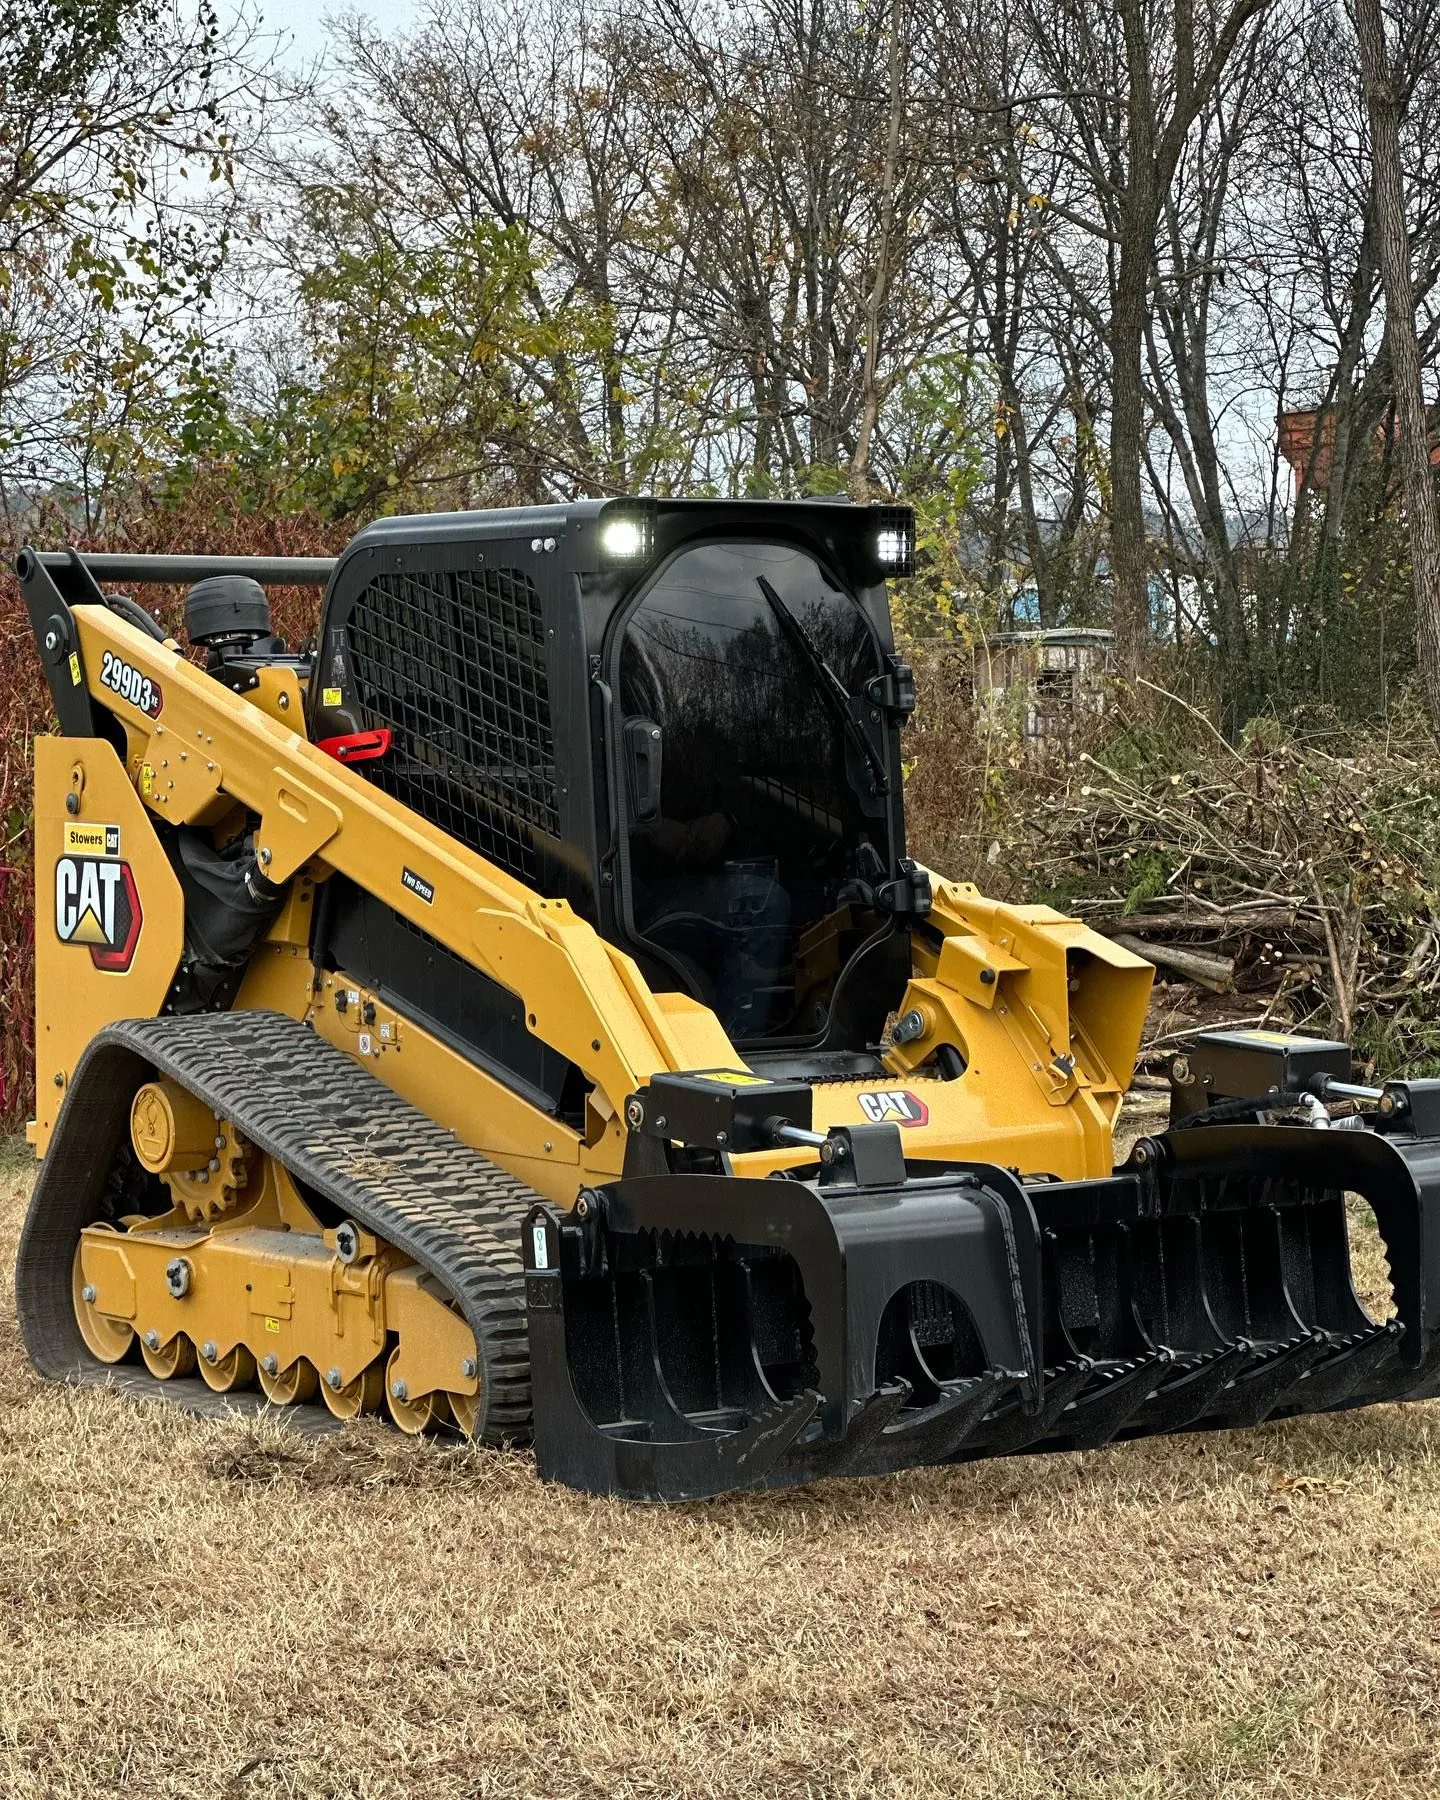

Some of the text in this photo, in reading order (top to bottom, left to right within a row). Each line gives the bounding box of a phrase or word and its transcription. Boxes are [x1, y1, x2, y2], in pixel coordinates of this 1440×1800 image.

[100, 651, 151, 711] 299D3
[70, 831, 118, 848] Stowers CAT
[56, 858, 121, 945] CAT
[858, 1091, 914, 1122] CAT
